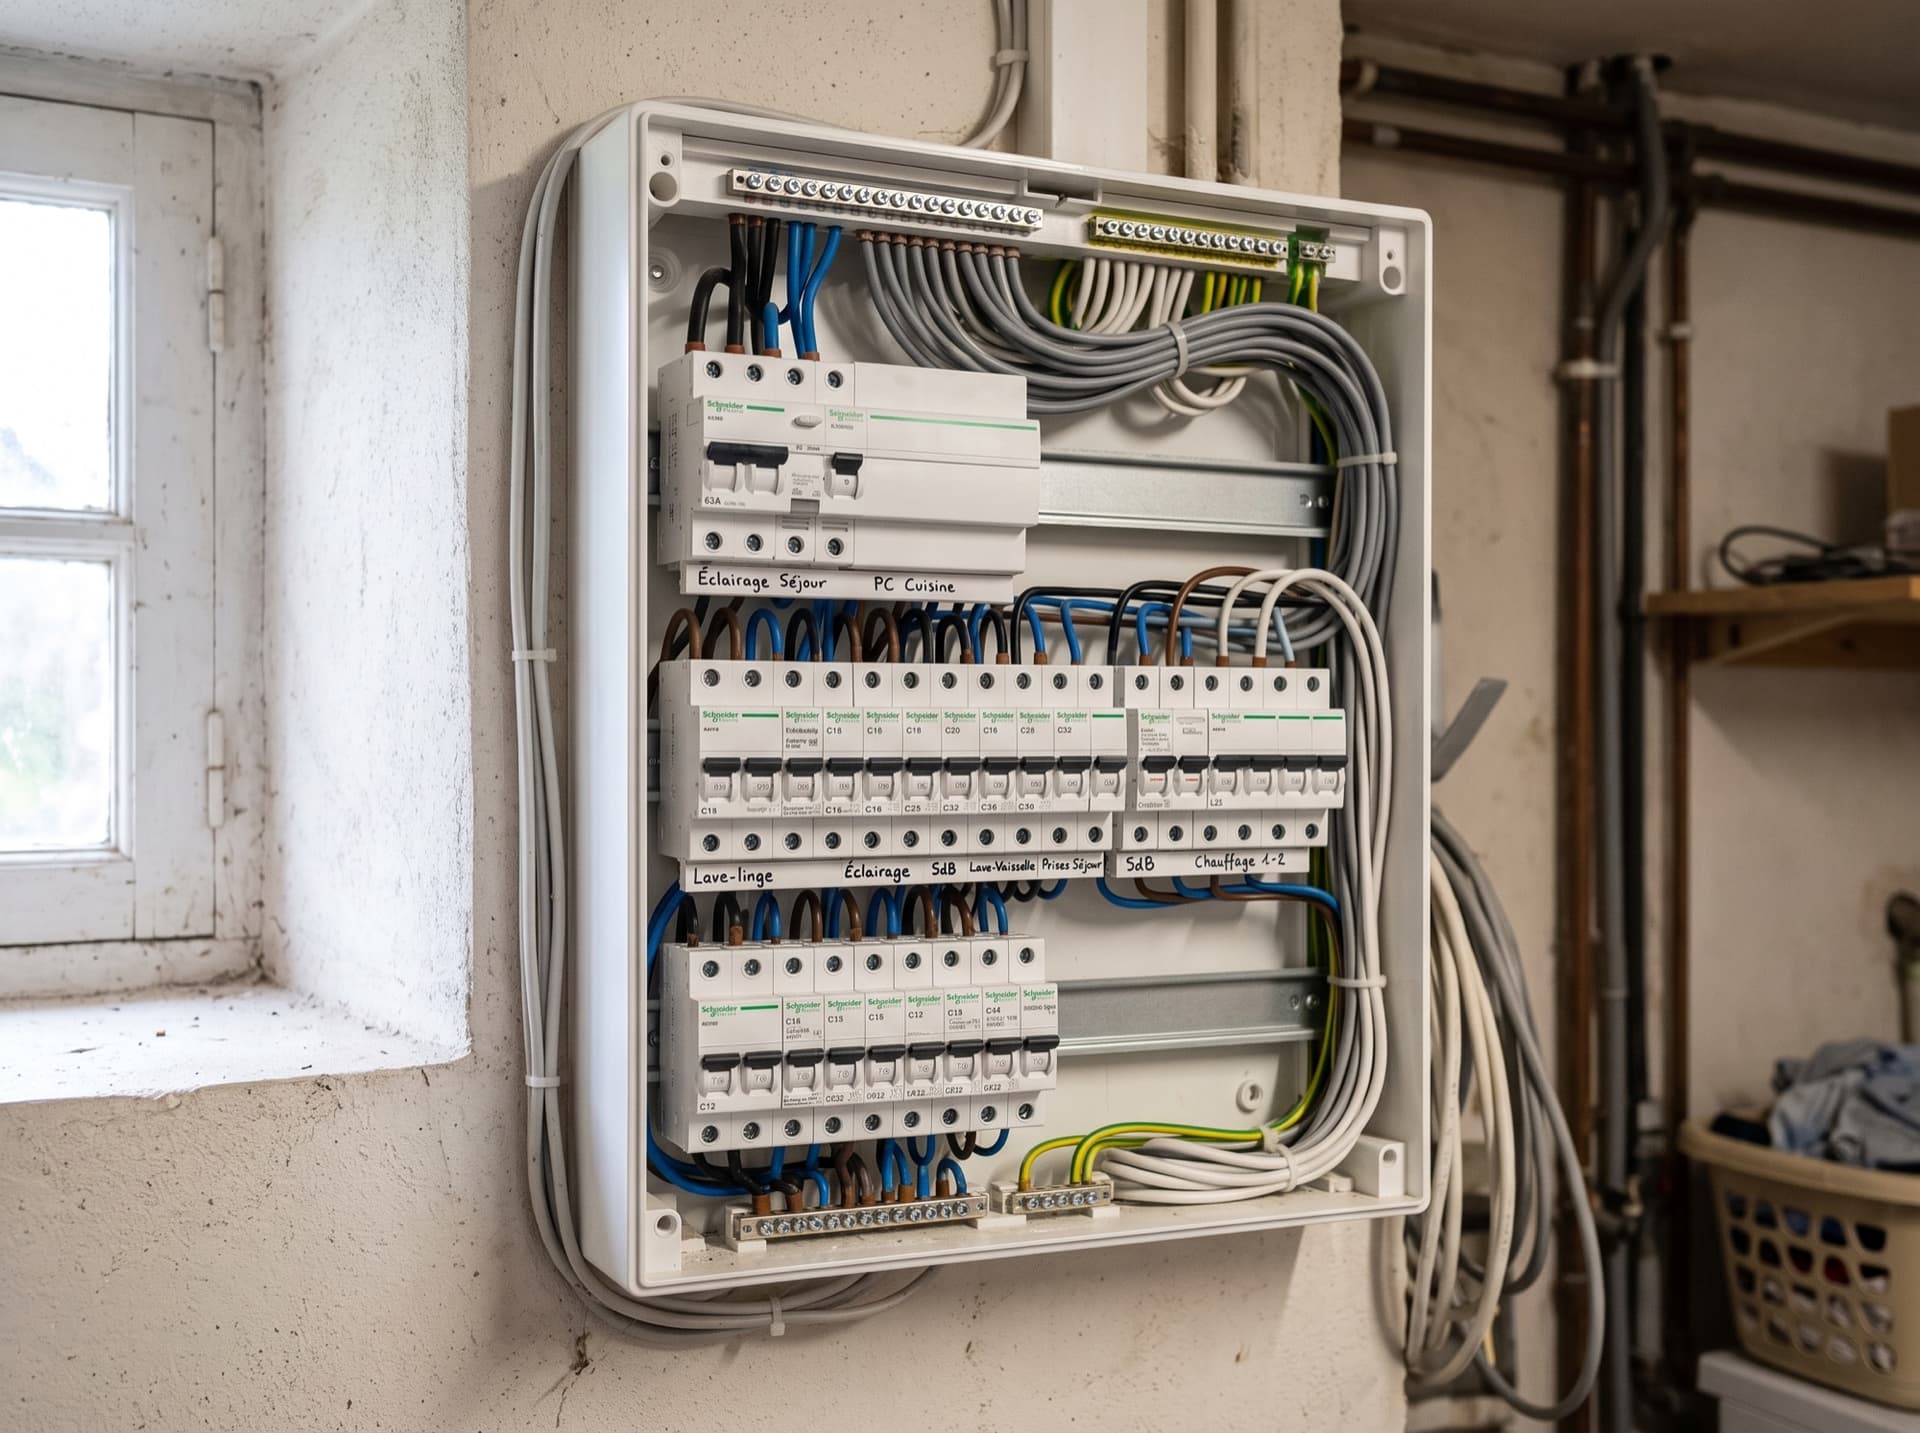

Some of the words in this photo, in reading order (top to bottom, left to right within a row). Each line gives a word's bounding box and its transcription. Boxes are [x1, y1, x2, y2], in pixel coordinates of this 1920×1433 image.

[704, 496, 721, 505] 63A
[698, 566, 770, 593] Éclairage
[780, 573, 828, 593] Séjour
[874, 576, 894, 591] PC
[904, 578, 956, 593] Cuisine
[945, 727, 960, 735] C20
[1057, 727, 1072, 735] C32
[931, 862, 957, 876] SdB
[969, 860, 1036, 873] Lave-Vaisselle
[1042, 859, 1070, 871] Prises
[1073, 857, 1103, 874] Séjour
[1126, 856, 1155, 871] SdB
[1194, 853, 1256, 872] Chauffage
[693, 866, 774, 887] Lave-linge
[844, 861, 911, 883] Éclairage
[699, 1102, 716, 1111] C12
